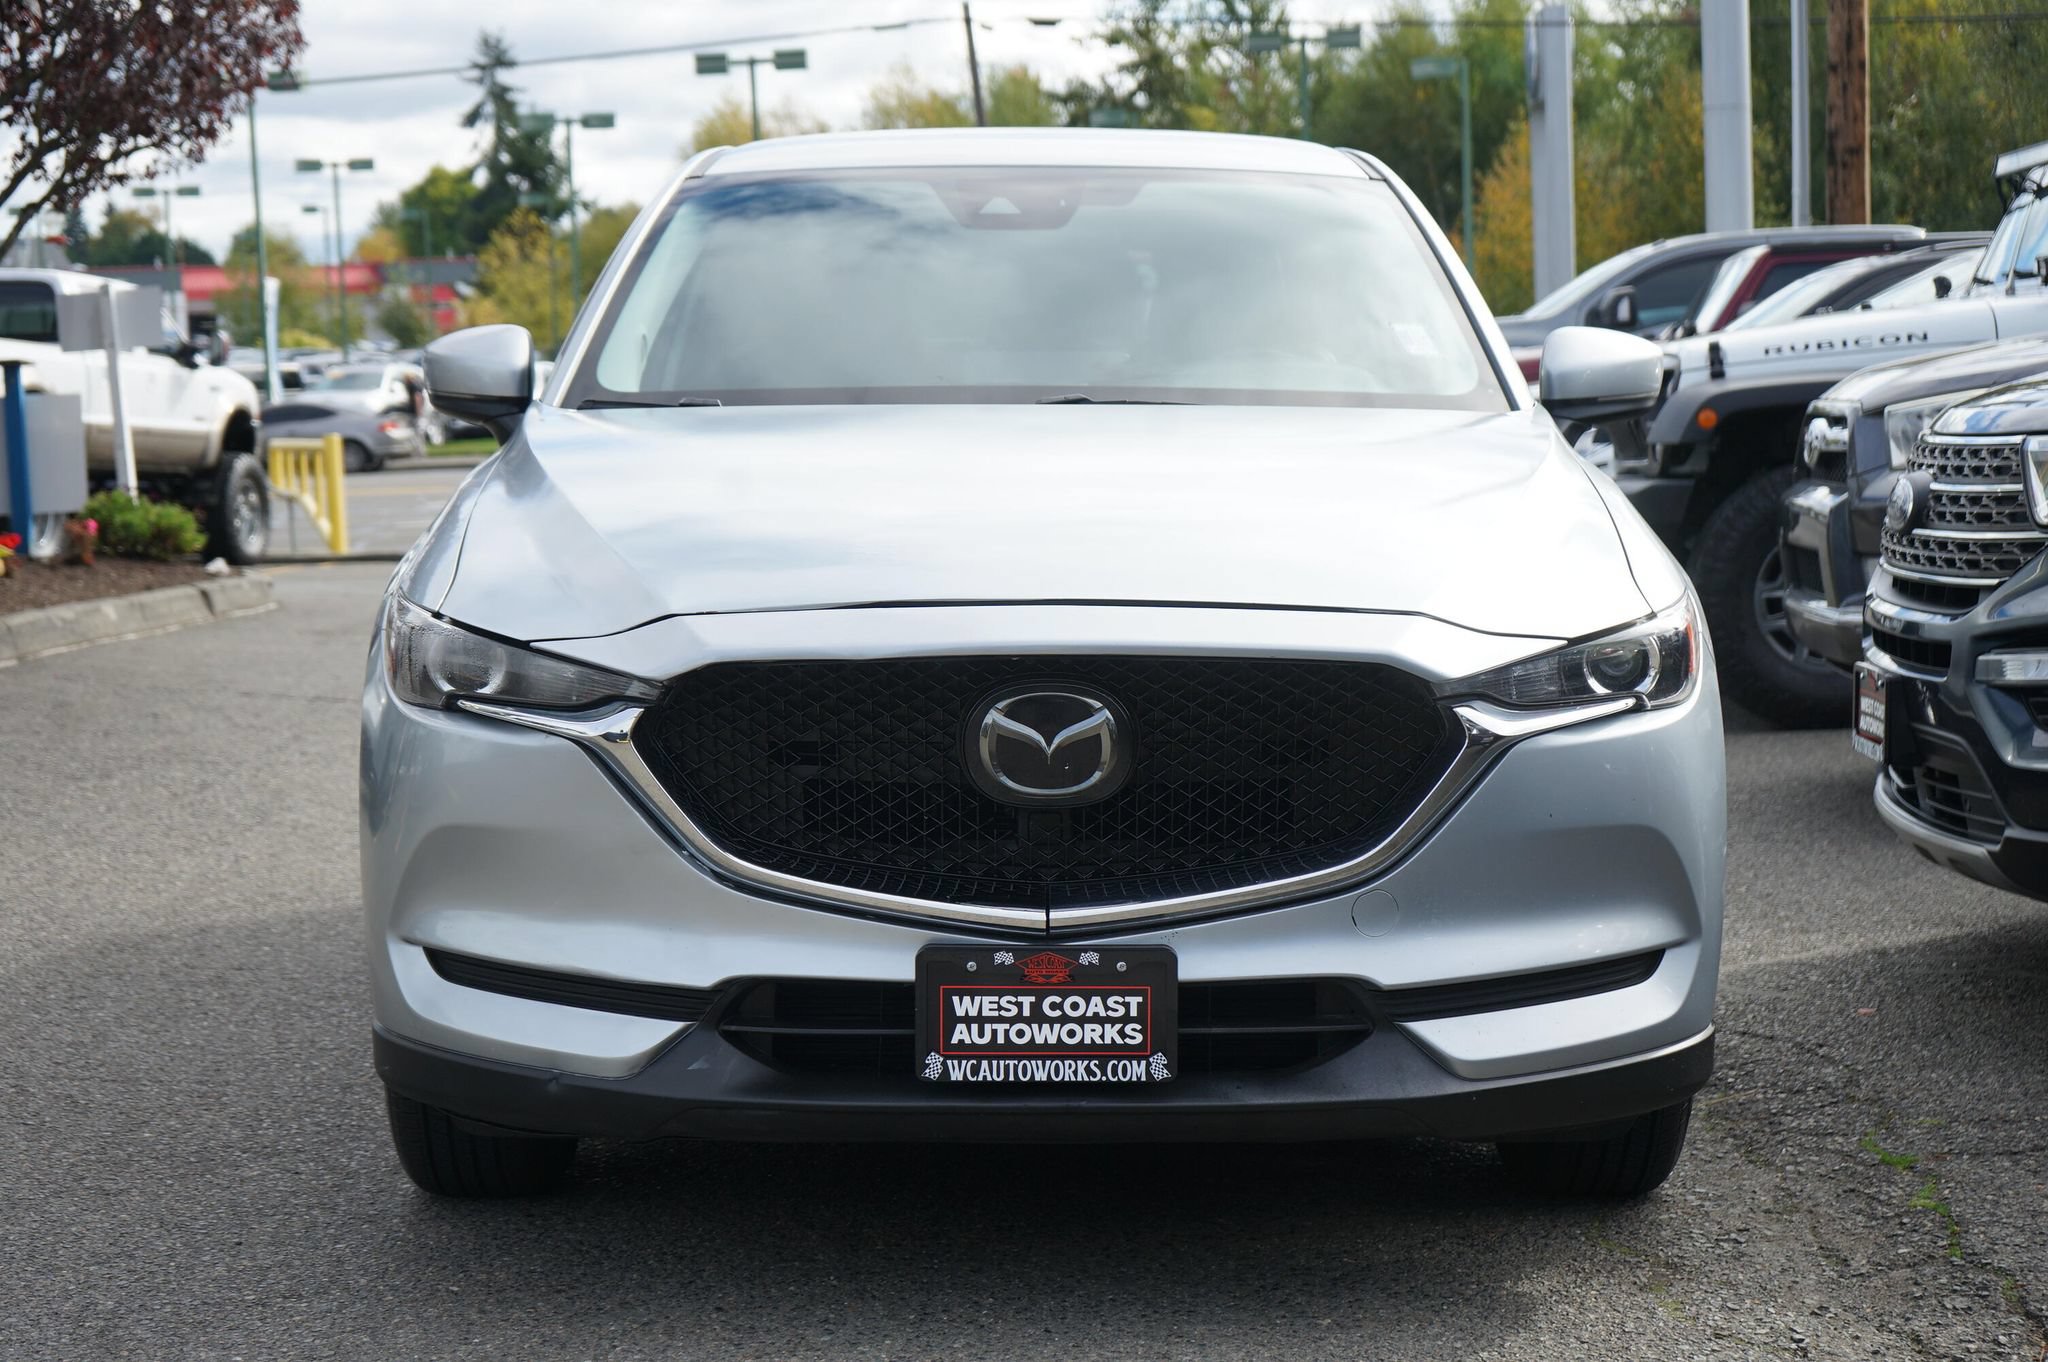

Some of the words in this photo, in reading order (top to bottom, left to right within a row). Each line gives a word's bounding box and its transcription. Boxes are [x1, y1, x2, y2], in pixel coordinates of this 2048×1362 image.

[1764, 332, 1928, 355] RUBICON
[952, 996, 1036, 1018] WEST
[1042, 995, 1144, 1018] COAST
[950, 1023, 1144, 1045] AUTOWORKS
[947, 1059, 1147, 1082] WCAUTOWORKS.COM
